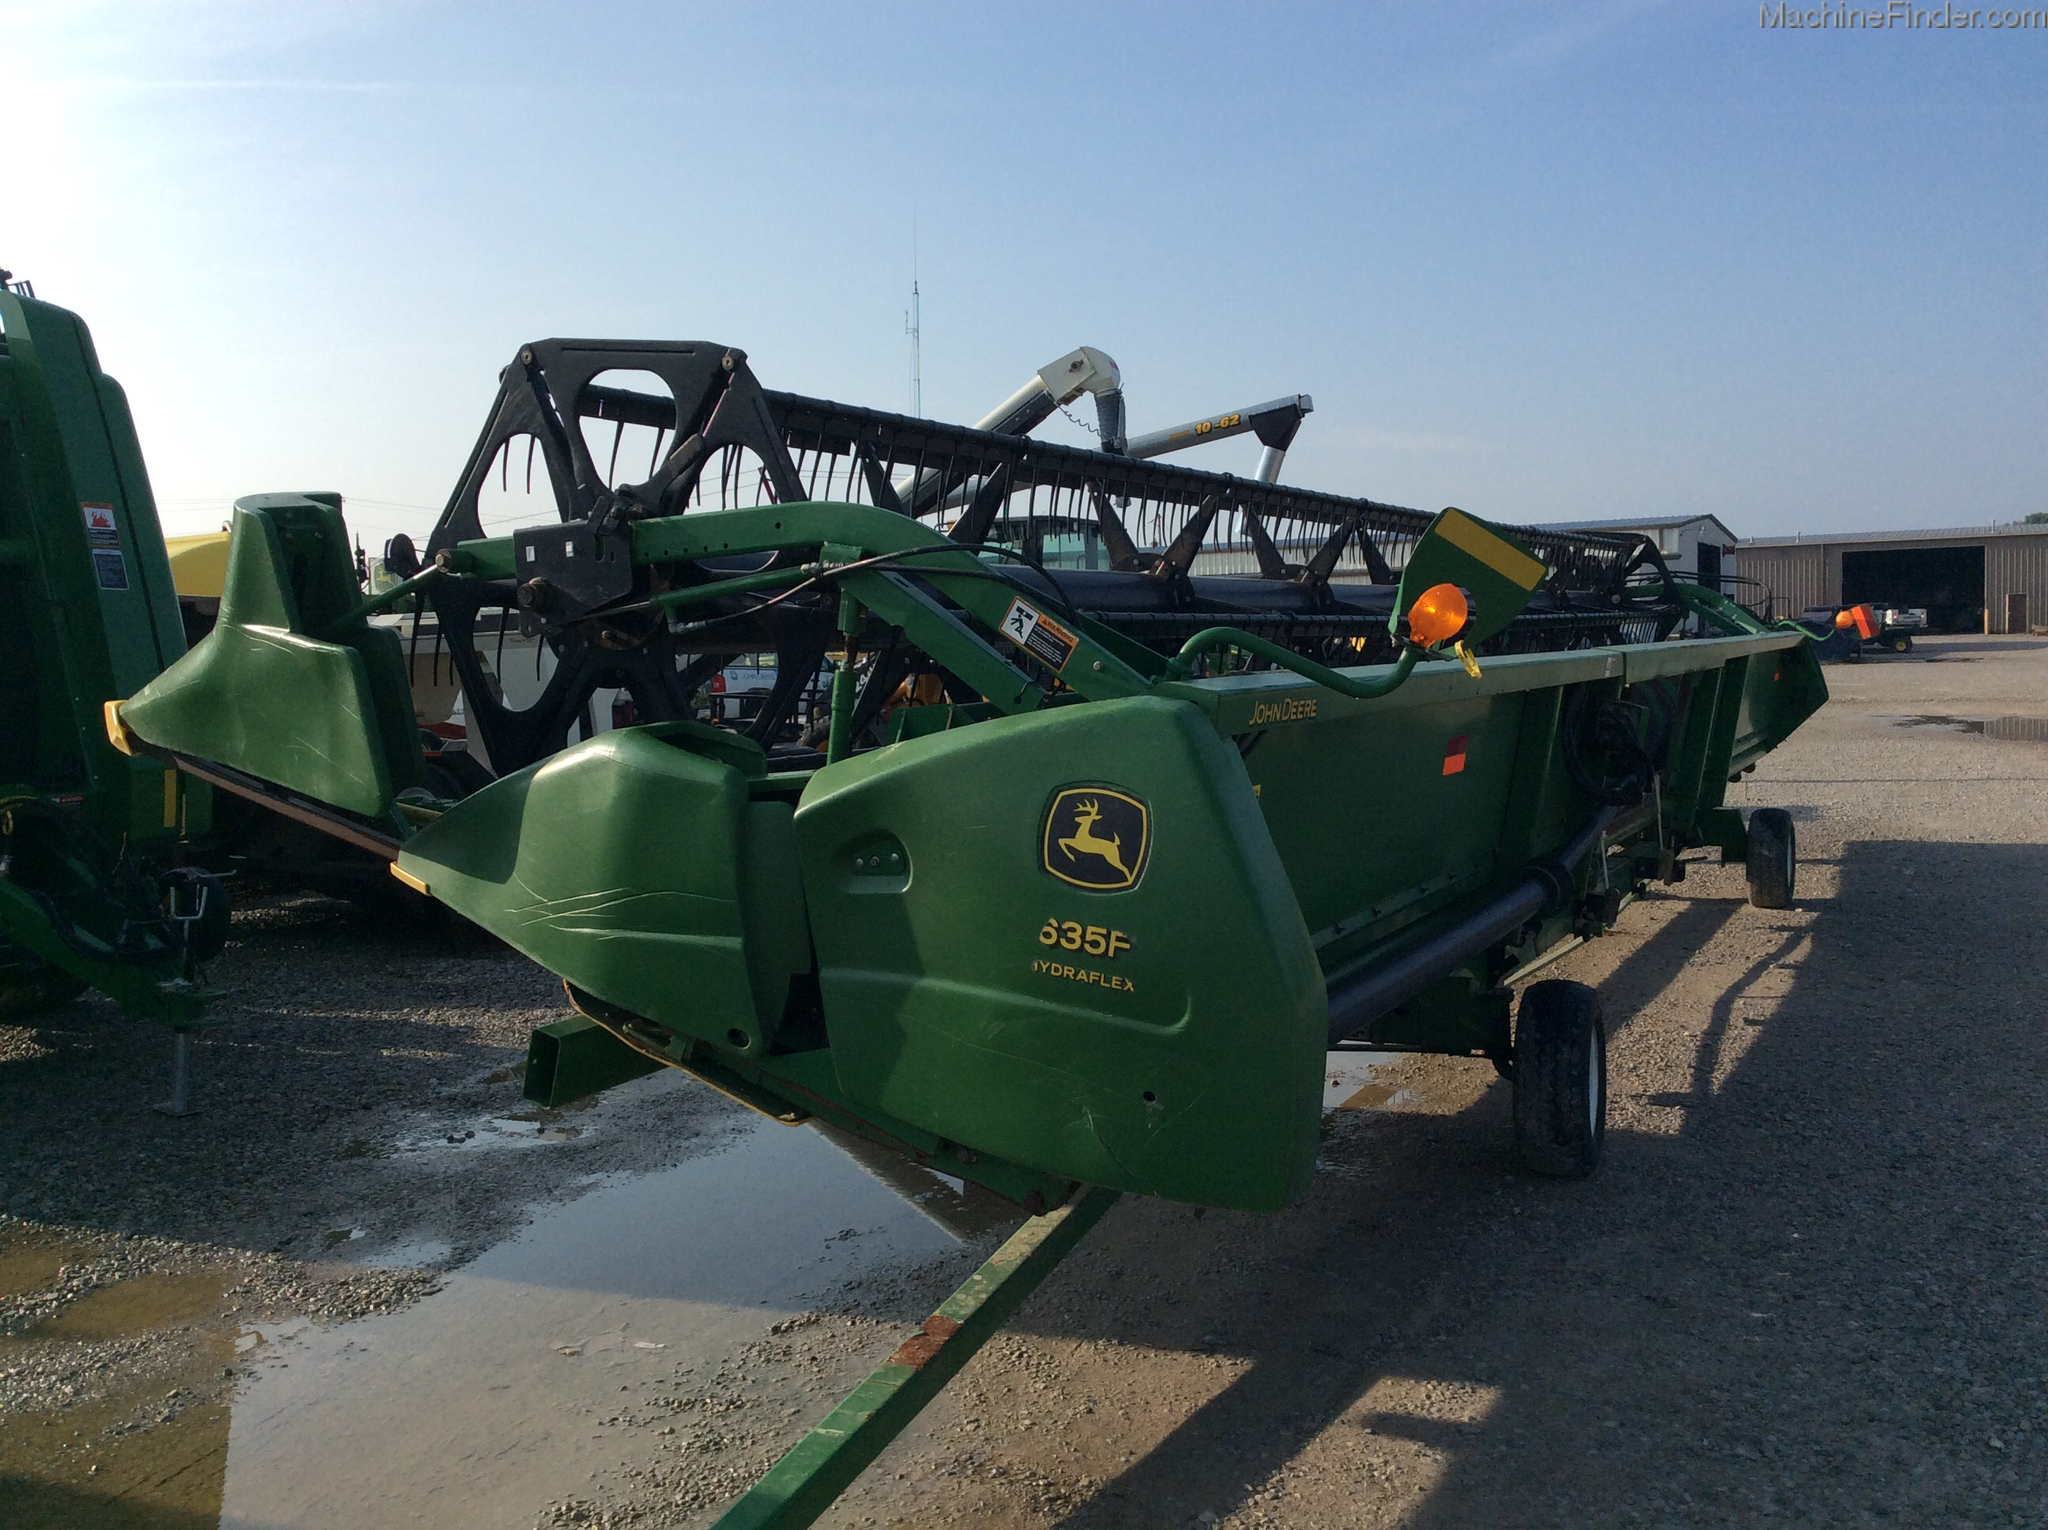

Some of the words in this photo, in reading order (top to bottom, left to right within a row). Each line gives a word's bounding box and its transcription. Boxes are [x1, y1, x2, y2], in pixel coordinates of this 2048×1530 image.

[1248, 701, 1282, 725] JOHN
[1281, 698, 1318, 721] DEERE
[1039, 917, 1131, 958] 635F
